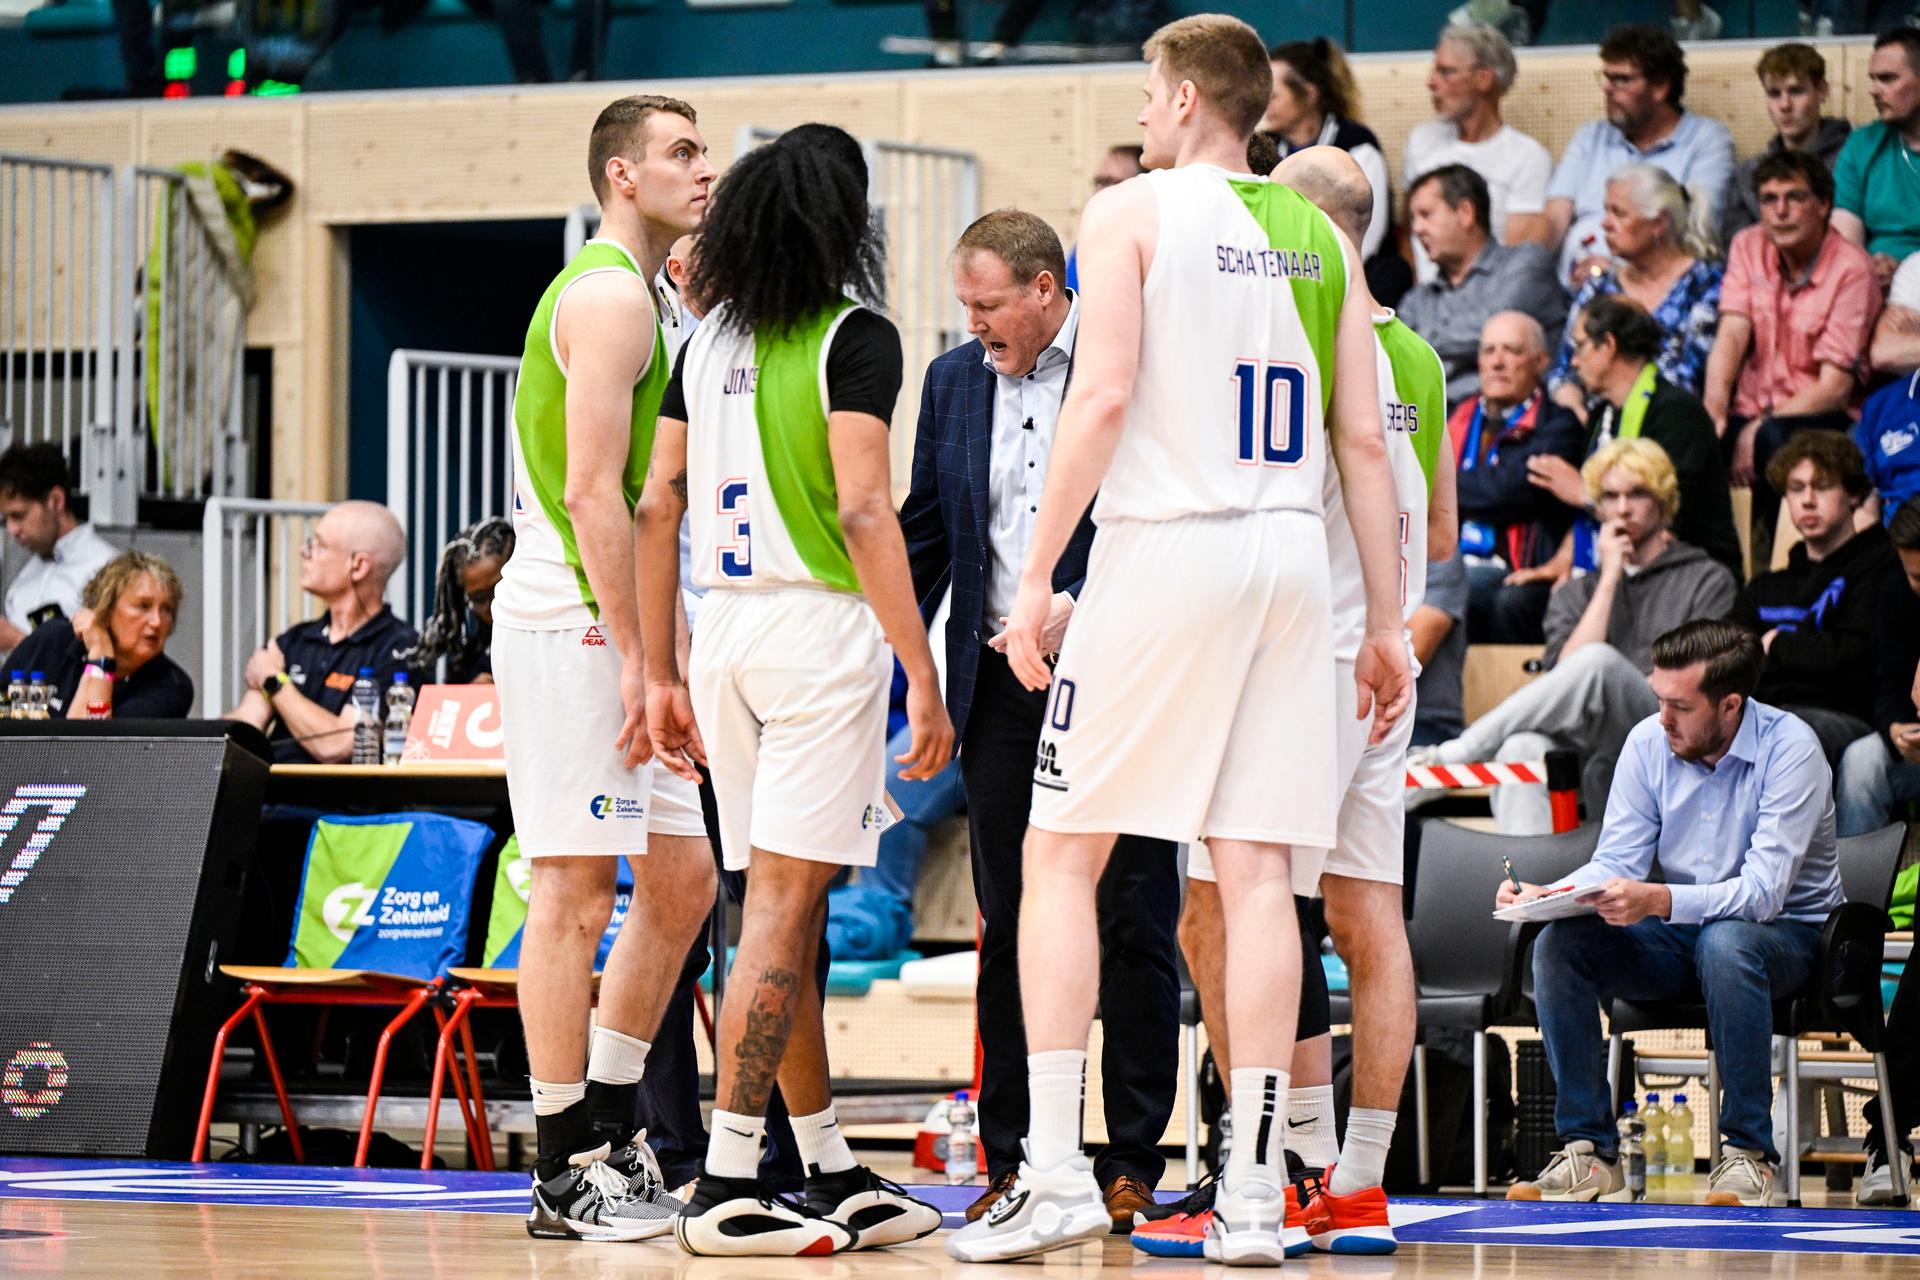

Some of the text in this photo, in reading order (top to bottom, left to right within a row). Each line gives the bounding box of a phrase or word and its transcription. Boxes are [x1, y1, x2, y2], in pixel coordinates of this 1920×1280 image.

[1216, 245, 1321, 280] SCHATENAAR
[1231, 358, 1310, 468] 10
[716, 476, 752, 582] 3
[582, 638, 607, 646] PEAK
[616, 797, 631, 806] Zorg
[382, 886, 440, 910] Zorg en
[379, 902, 451, 926] Zekerheid
